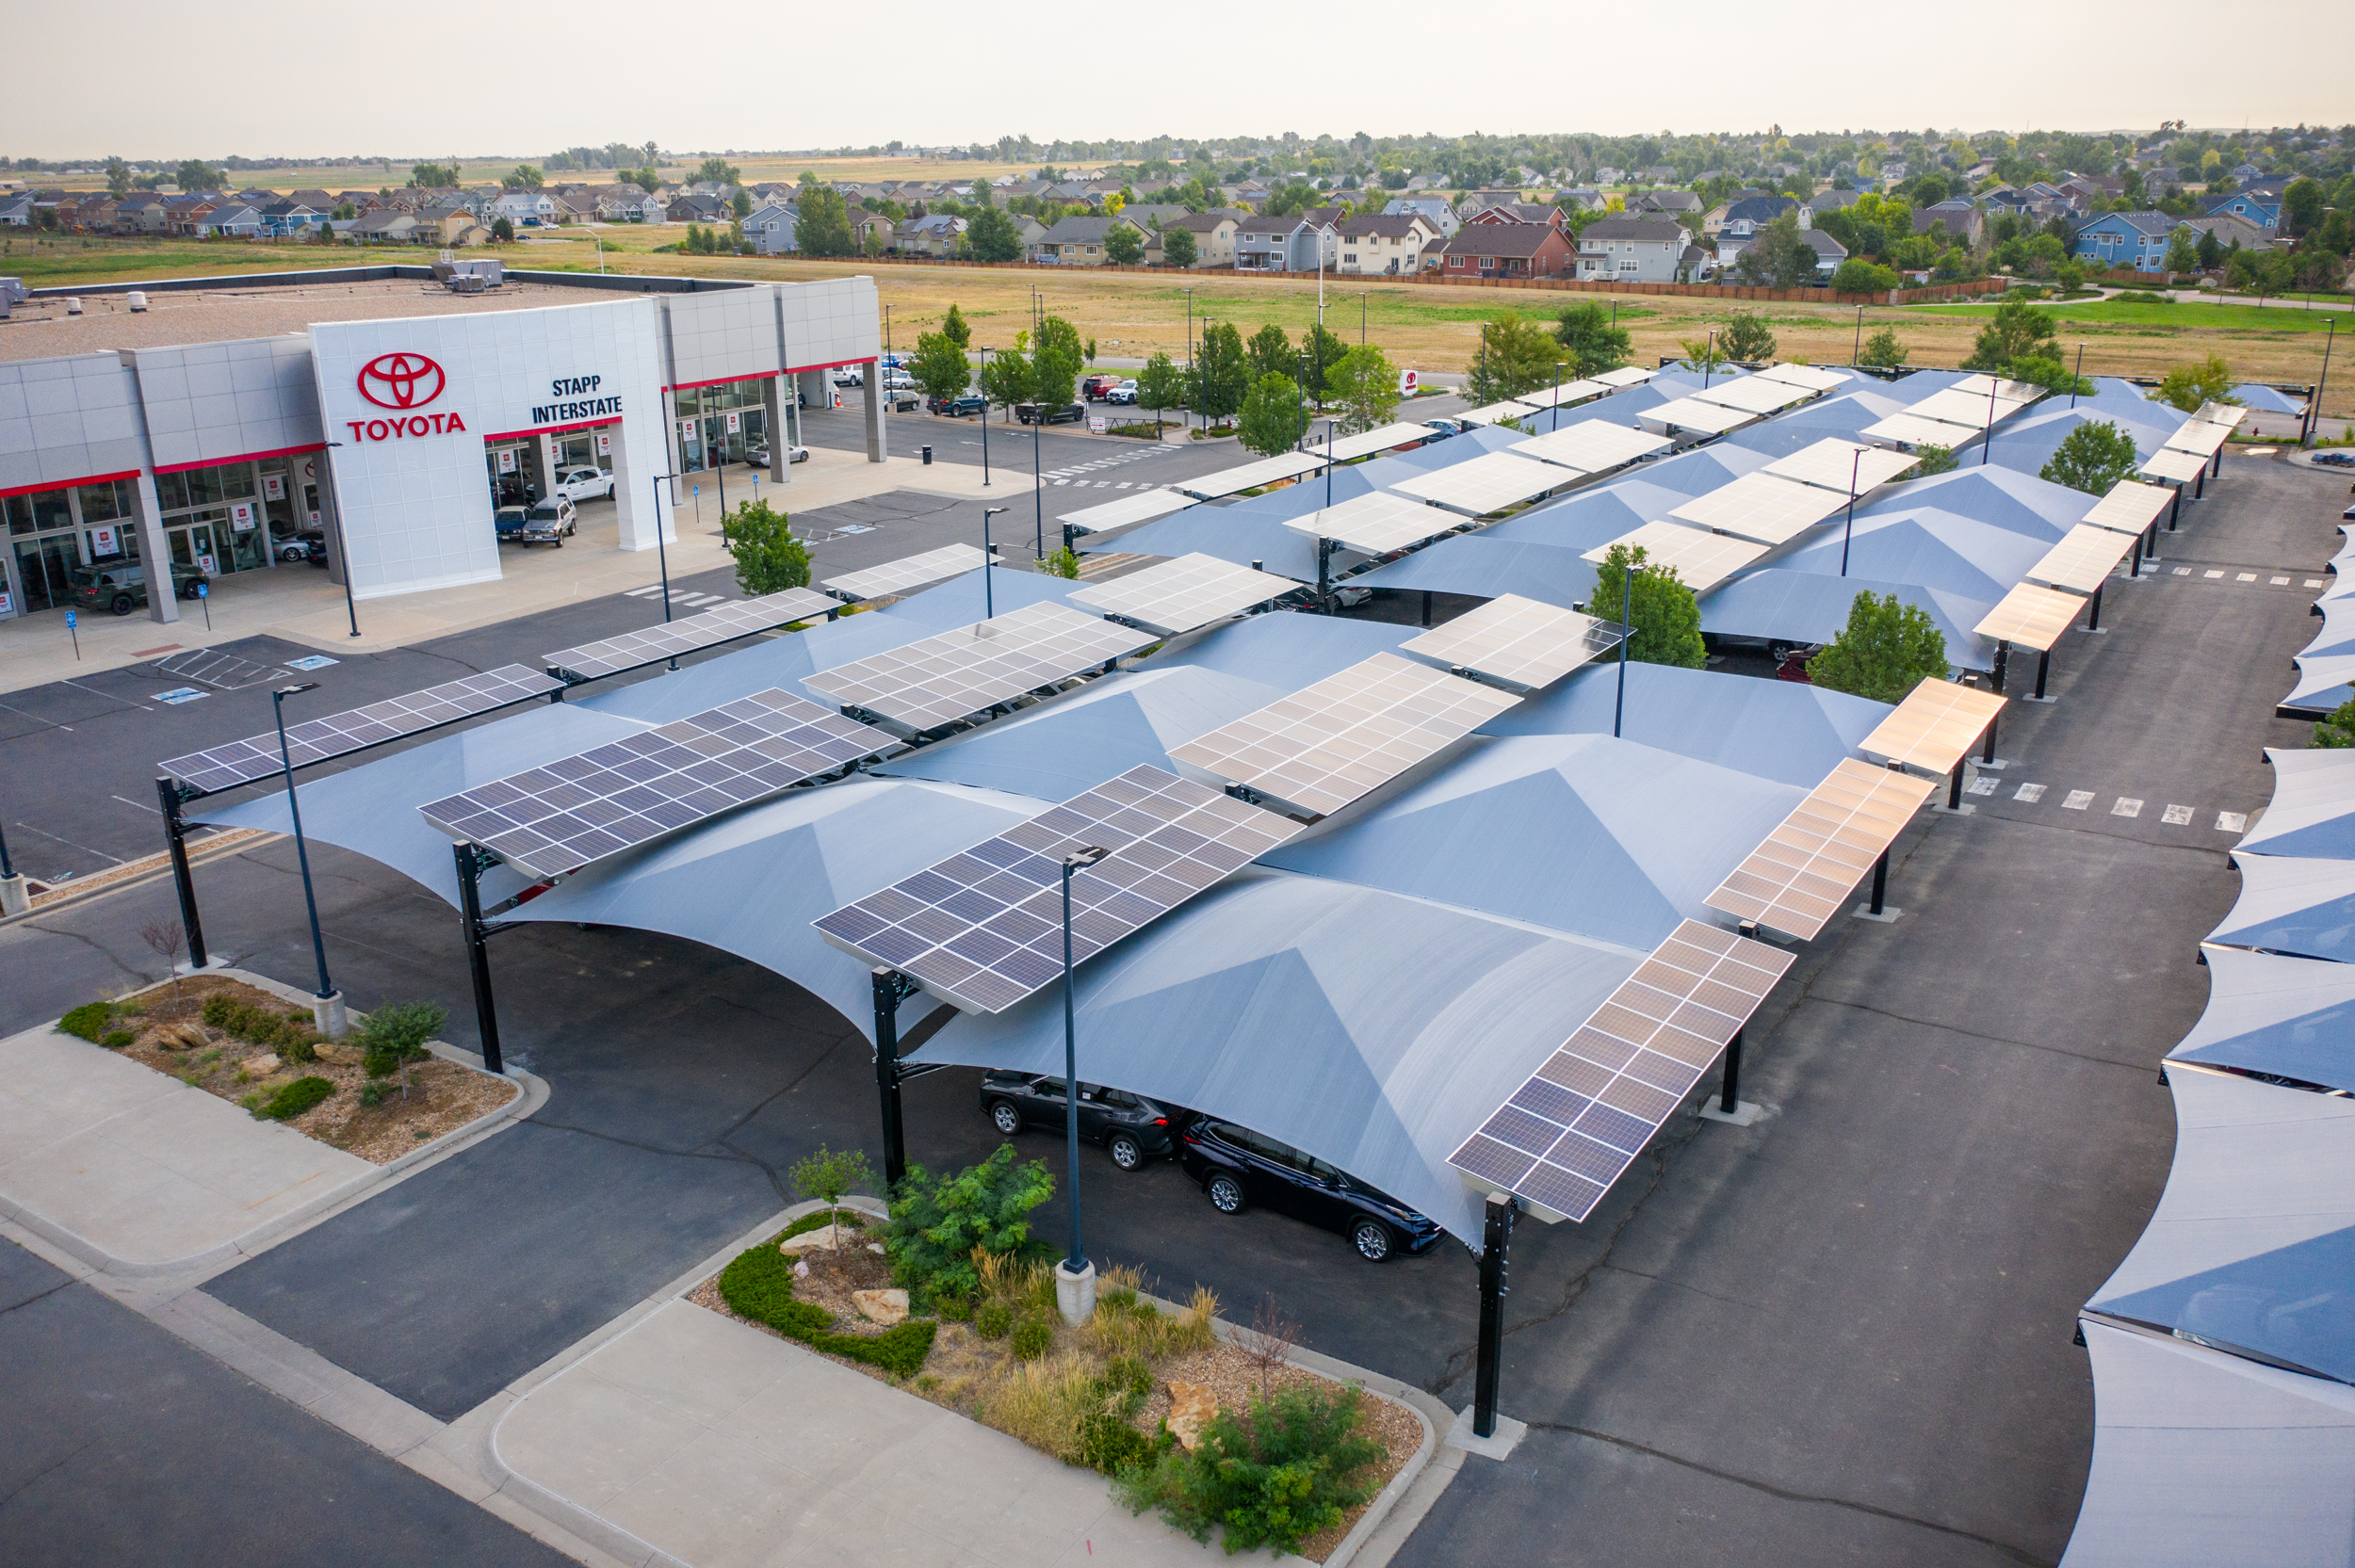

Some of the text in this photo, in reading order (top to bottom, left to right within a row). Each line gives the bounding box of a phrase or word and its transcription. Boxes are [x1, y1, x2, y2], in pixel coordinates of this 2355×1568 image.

[553, 375, 601, 396] STAPP
[532, 396, 623, 424] INTERSTATE
[347, 412, 466, 443] TOYOTA
